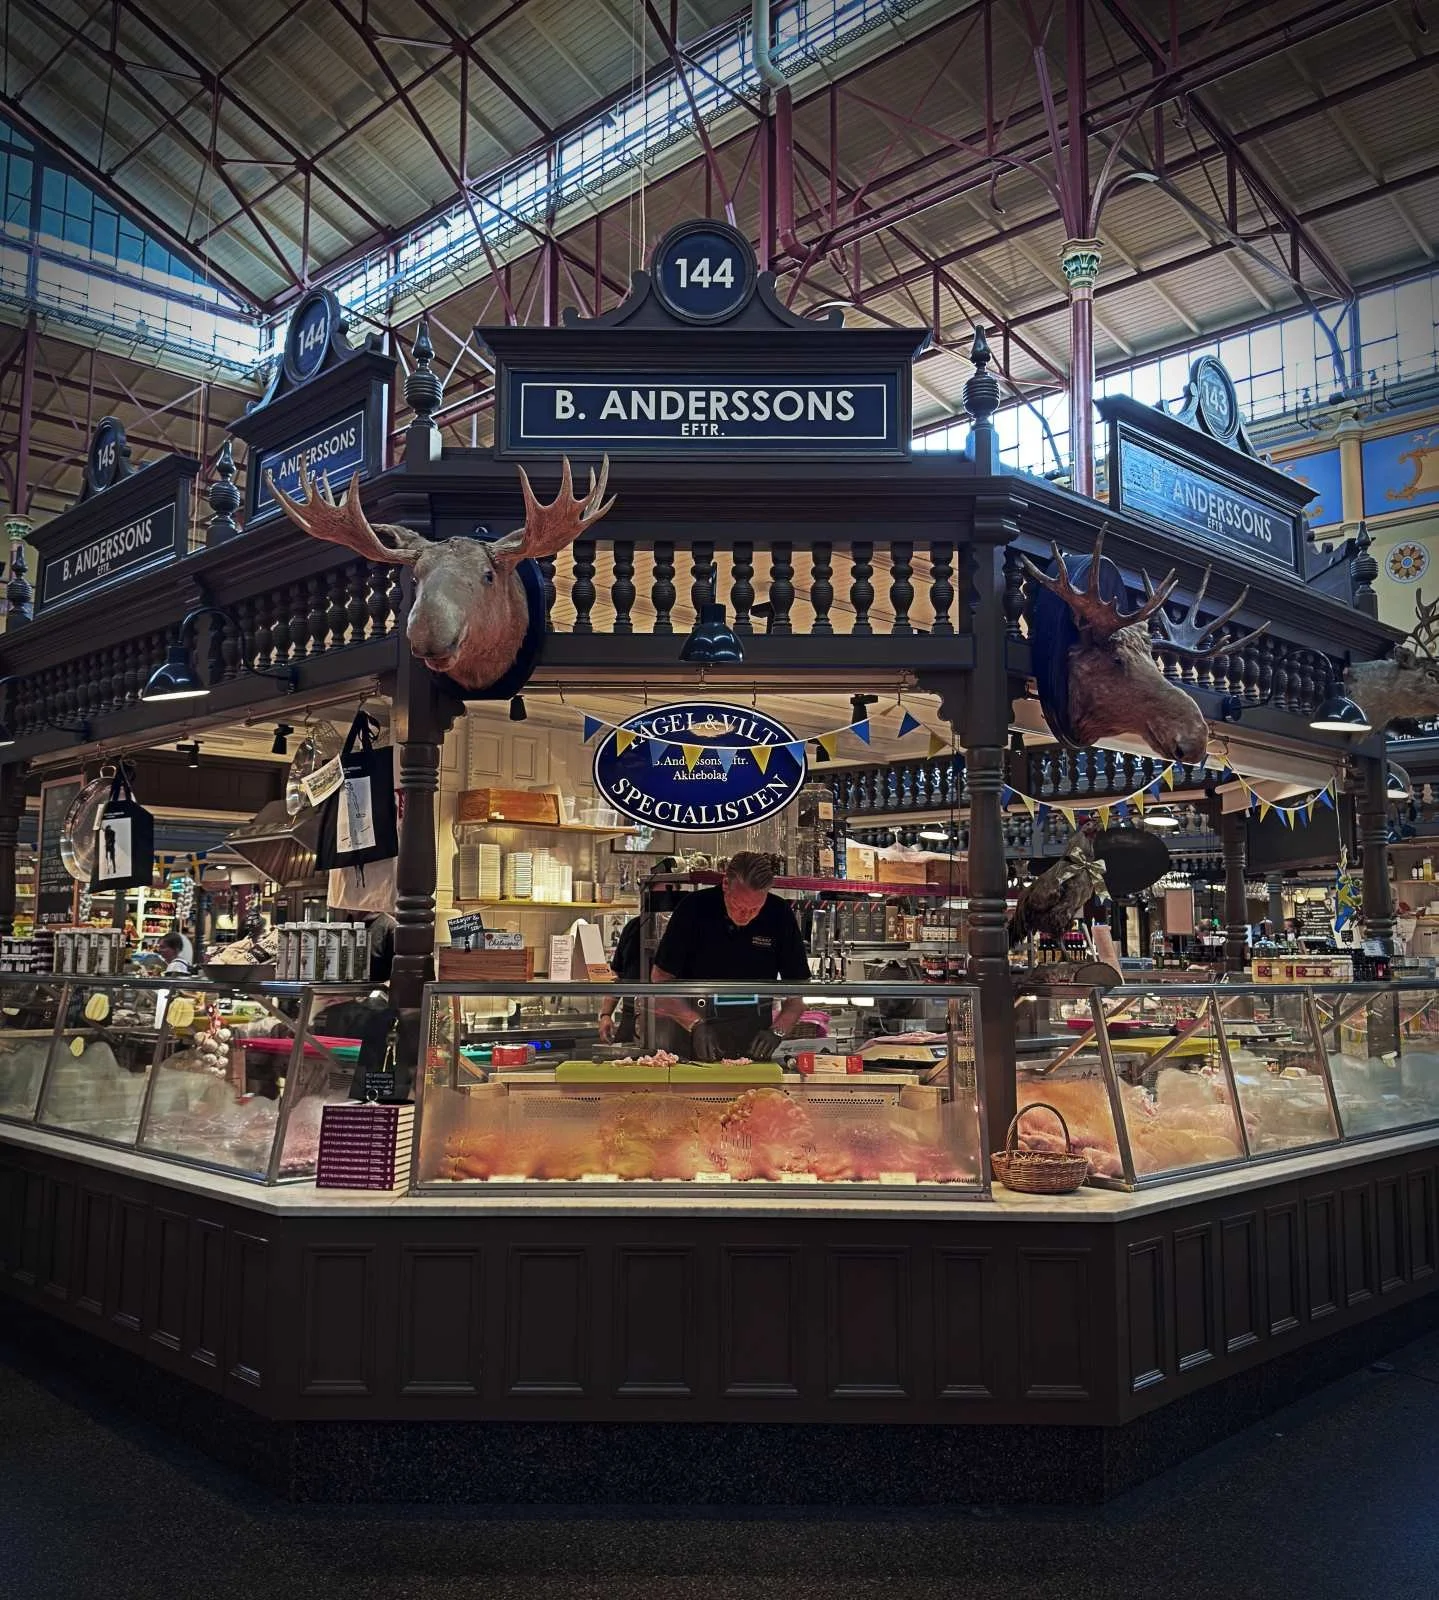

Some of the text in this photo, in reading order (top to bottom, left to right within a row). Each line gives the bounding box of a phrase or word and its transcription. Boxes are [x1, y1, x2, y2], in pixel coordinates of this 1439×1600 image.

[675, 258, 735, 288] 144
[298, 316, 326, 357] 144
[555, 389, 855, 421] B. ANDERSSONS
[1203, 382, 1228, 417] 143
[681, 422, 726, 436] EFTR.
[97, 441, 117, 471] 145
[1172, 479, 1272, 543] ANDERSSONS
[1207, 516, 1226, 535] EFTR.
[62, 518, 152, 581] B. ANDERSSONS
[97, 562, 112, 576] EFTR.
[704, 713, 720, 731] &
[720, 713, 779, 746] VILT
[672, 769, 728, 782] Aktiebolag
[611, 773, 790, 825] SPECIALISTEN
